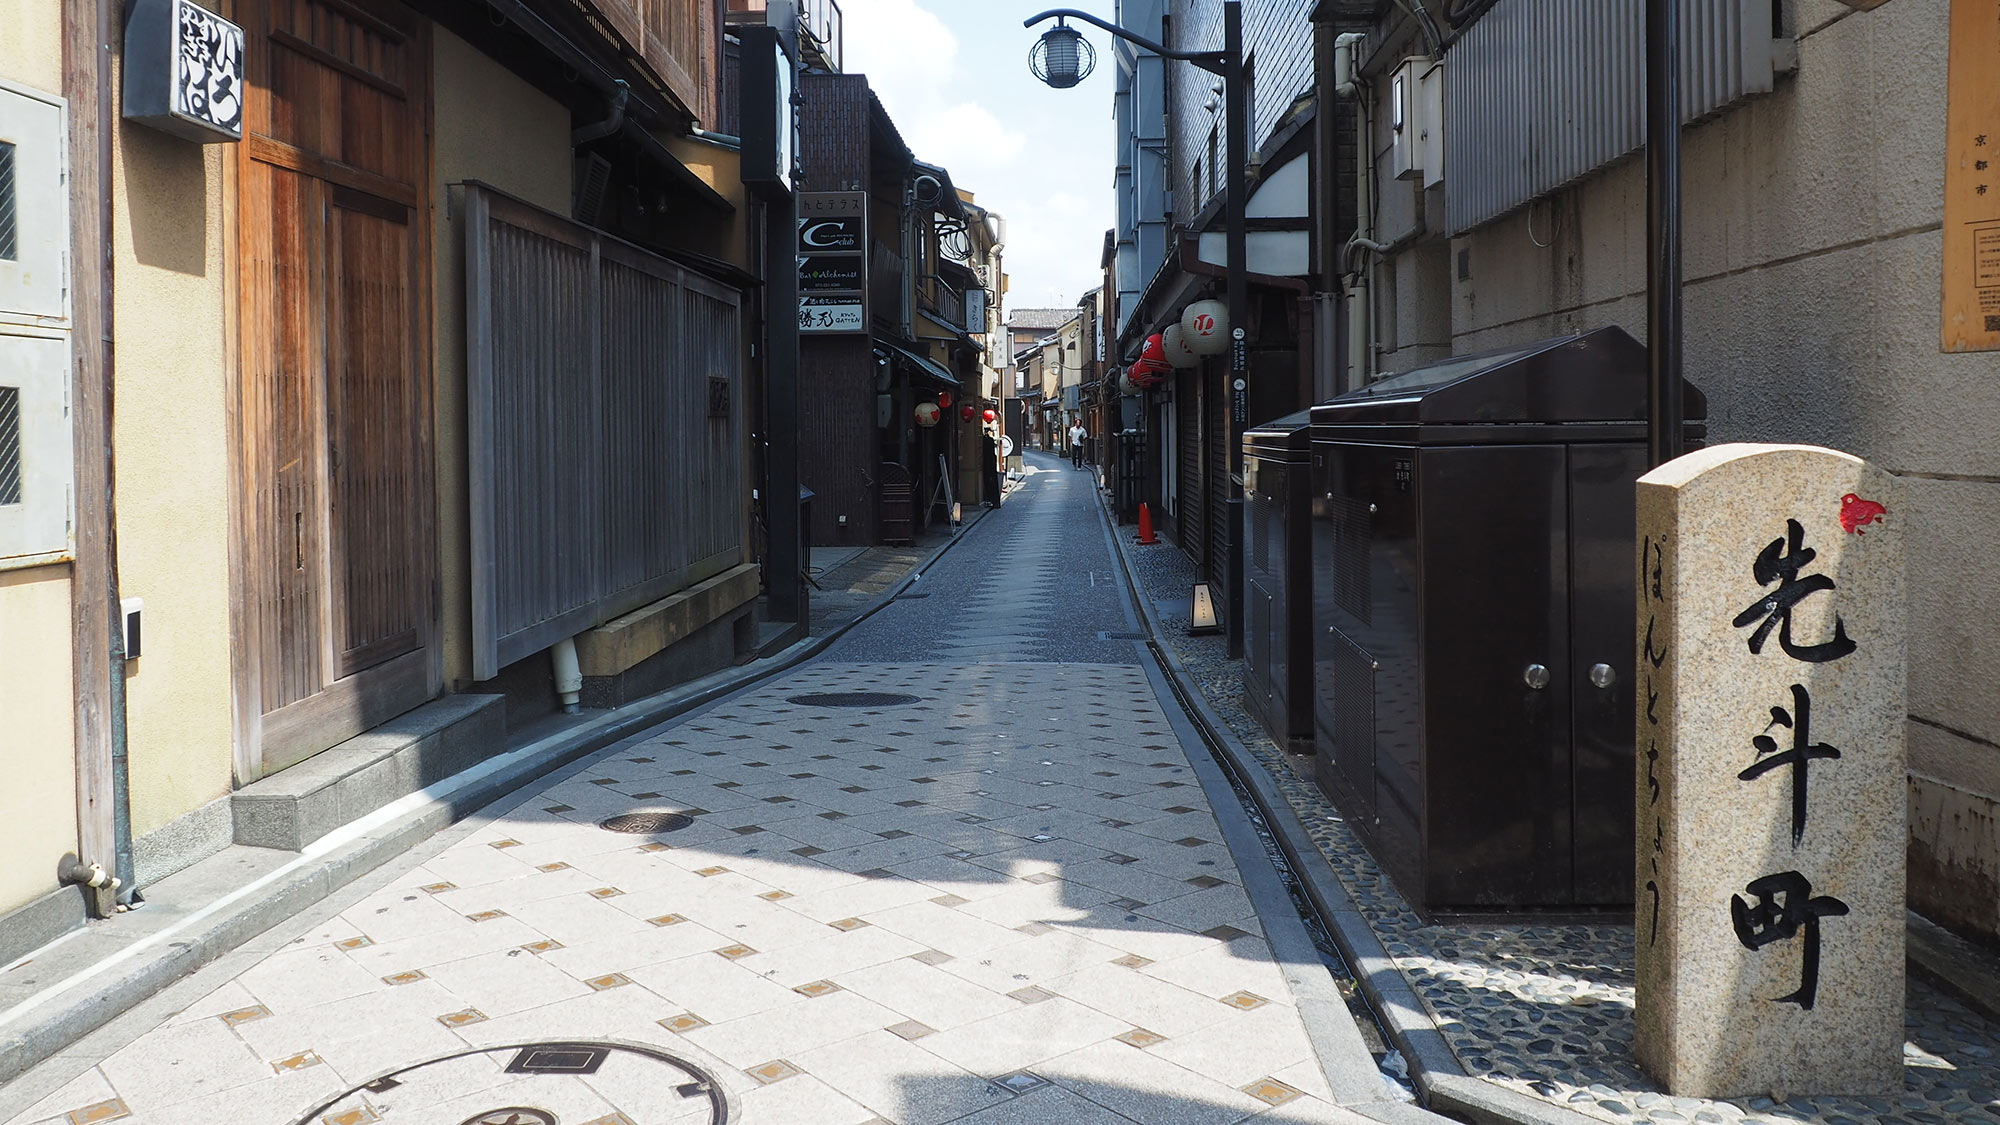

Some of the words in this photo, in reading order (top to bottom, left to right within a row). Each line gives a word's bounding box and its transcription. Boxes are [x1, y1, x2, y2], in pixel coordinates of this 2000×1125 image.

[1974, 134, 1988, 197] 京都市
[1642, 533, 1667, 949] ぽんとちょう
[1731, 518, 1857, 1011] 先斗町
